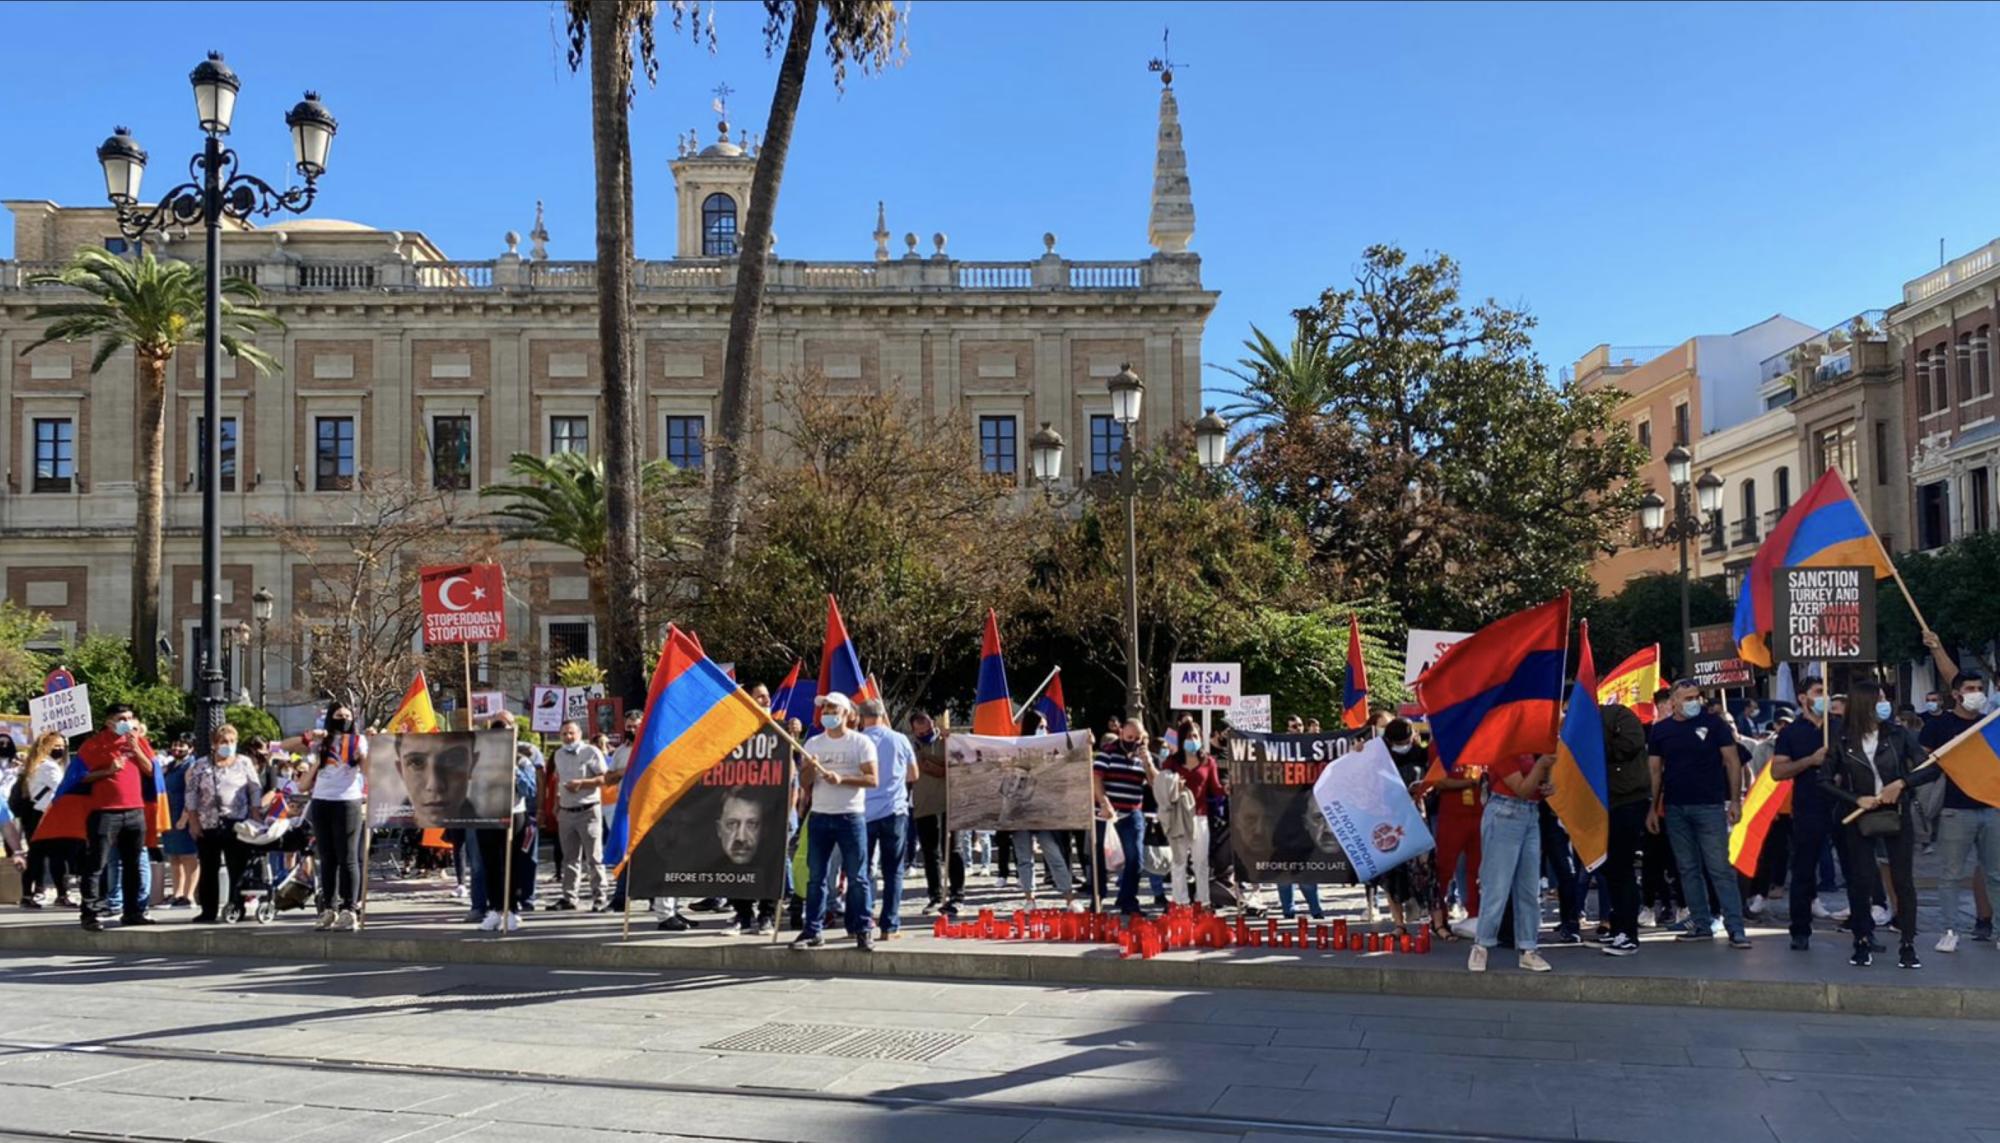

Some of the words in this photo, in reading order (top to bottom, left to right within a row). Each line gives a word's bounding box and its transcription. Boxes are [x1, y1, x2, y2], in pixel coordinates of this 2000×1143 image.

[1788, 570, 1859, 588] SANCTION
[1789, 588, 1833, 602] TURKEY
[1835, 587, 1859, 601] AND
[1789, 601, 1859, 615] AZERBAIJAN
[426, 611, 502, 627] STOPERDOGAN
[1789, 616, 1820, 635] FOR
[1823, 615, 1859, 634] WAR
[428, 624, 501, 641] STOPTURKEY
[1789, 635, 1860, 657] CRIMES
[1182, 670, 1230, 684] ARTSAJ
[1197, 685, 1212, 694] ES
[41, 691, 73, 709] TODOS
[1182, 693, 1232, 706] NUESTRO
[42, 704, 76, 722] SOMOS
[1230, 739, 1257, 761] WE
[1263, 740, 1306, 762] WILL
[1312, 737, 1351, 761] STO
[703, 760, 783, 786] ERDOGAN
[1341, 814, 1357, 834] NOS
[1352, 834, 1378, 876] IMPORTA
[1255, 860, 1288, 871] BEFORE
[1306, 861, 1326, 871] TOO
[1327, 861, 1346, 871] LATE
[664, 872, 697, 882] BEFORE
[715, 872, 735, 883] TOO
[736, 873, 756, 883] LATE
